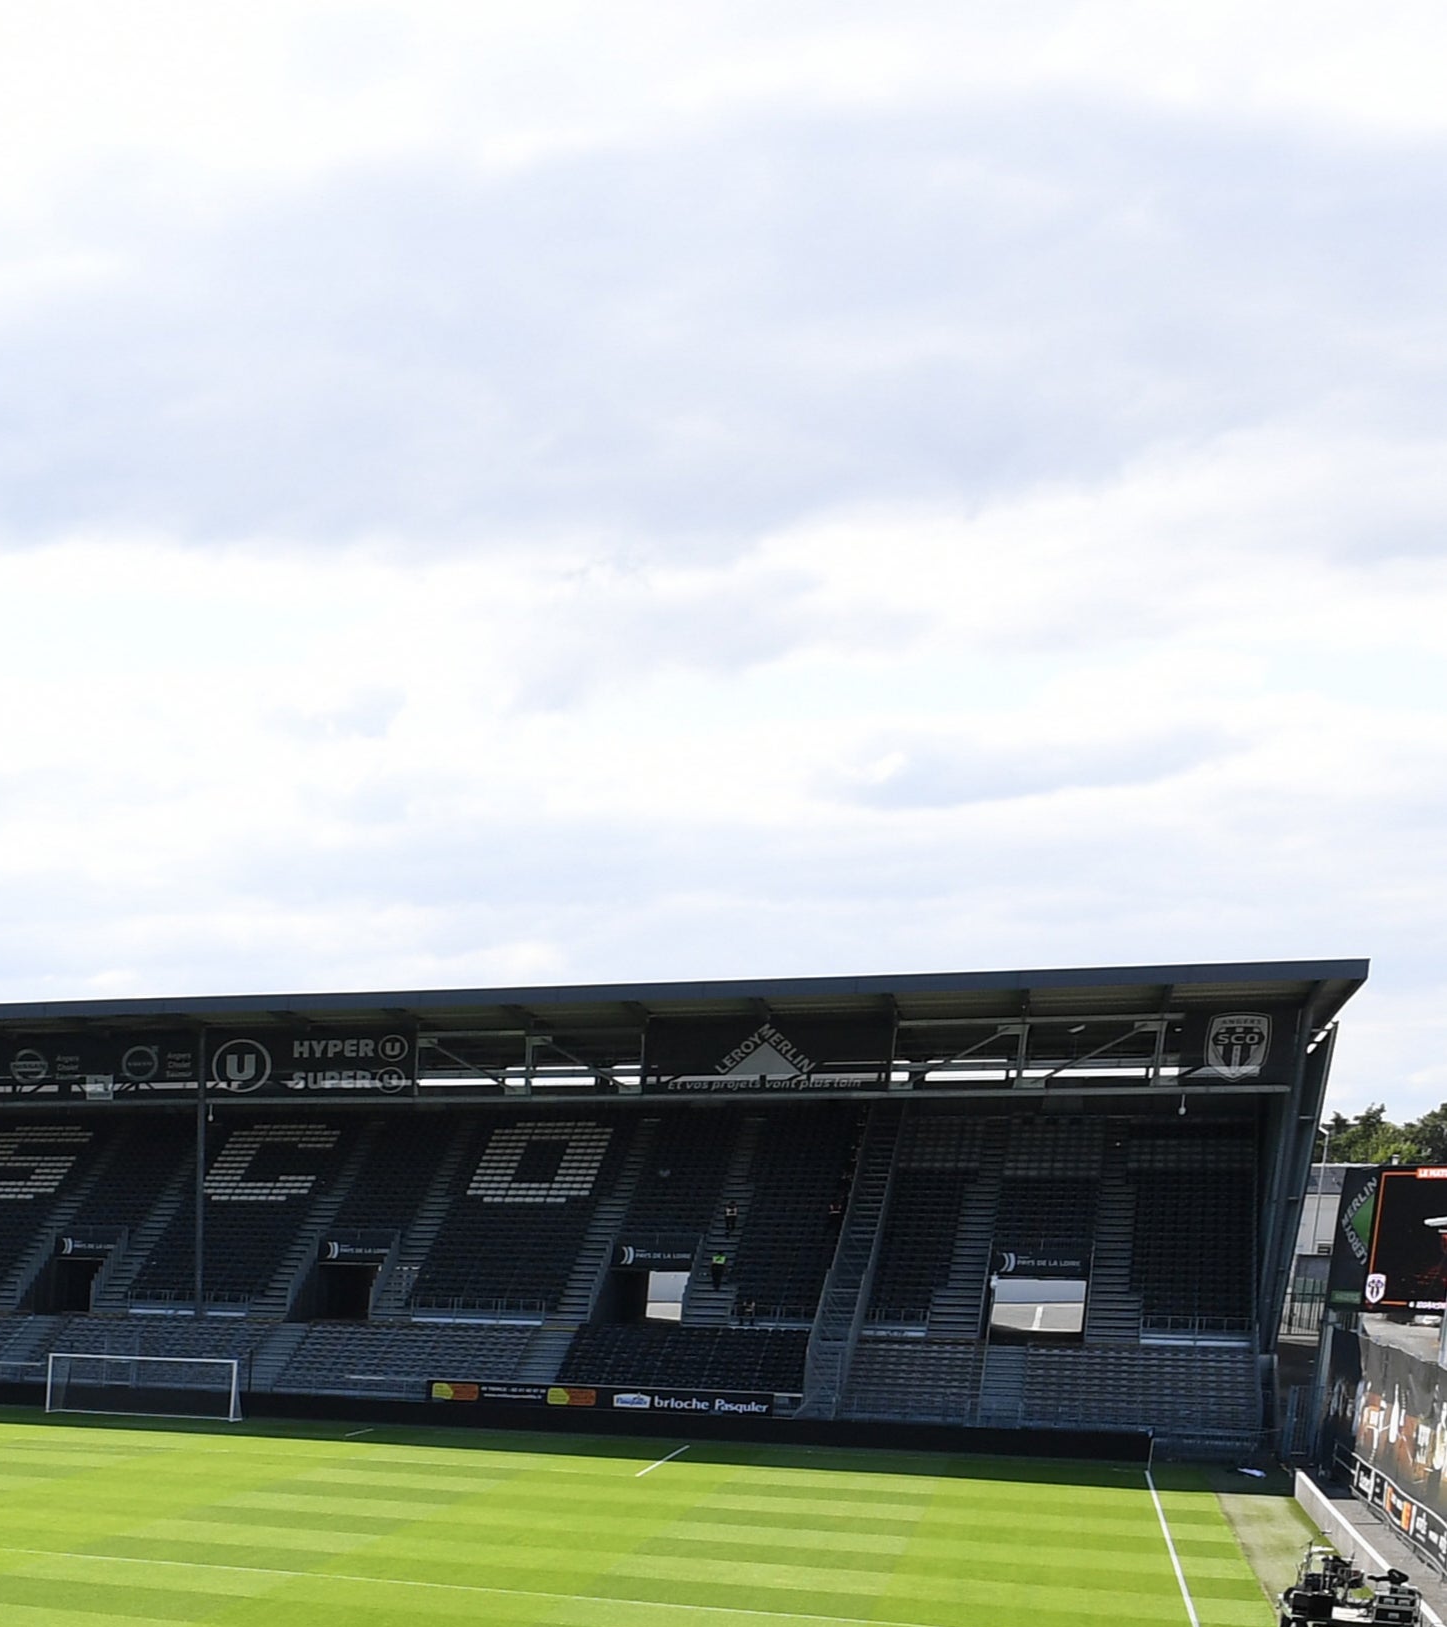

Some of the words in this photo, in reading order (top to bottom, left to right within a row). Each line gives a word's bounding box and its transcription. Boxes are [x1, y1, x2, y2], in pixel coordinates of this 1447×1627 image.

[1216, 1033, 1259, 1044] SCO
[293, 1039, 374, 1058] HYPER
[714, 1032, 762, 1074] LEROY
[757, 1023, 817, 1073] MERLIN
[292, 1070, 372, 1089] SUPER
[1341, 1176, 1378, 1227] MERLIN
[1343, 1225, 1368, 1265] LEROY
[654, 1395, 710, 1410] brioche
[714, 1398, 769, 1414] Pasquier
